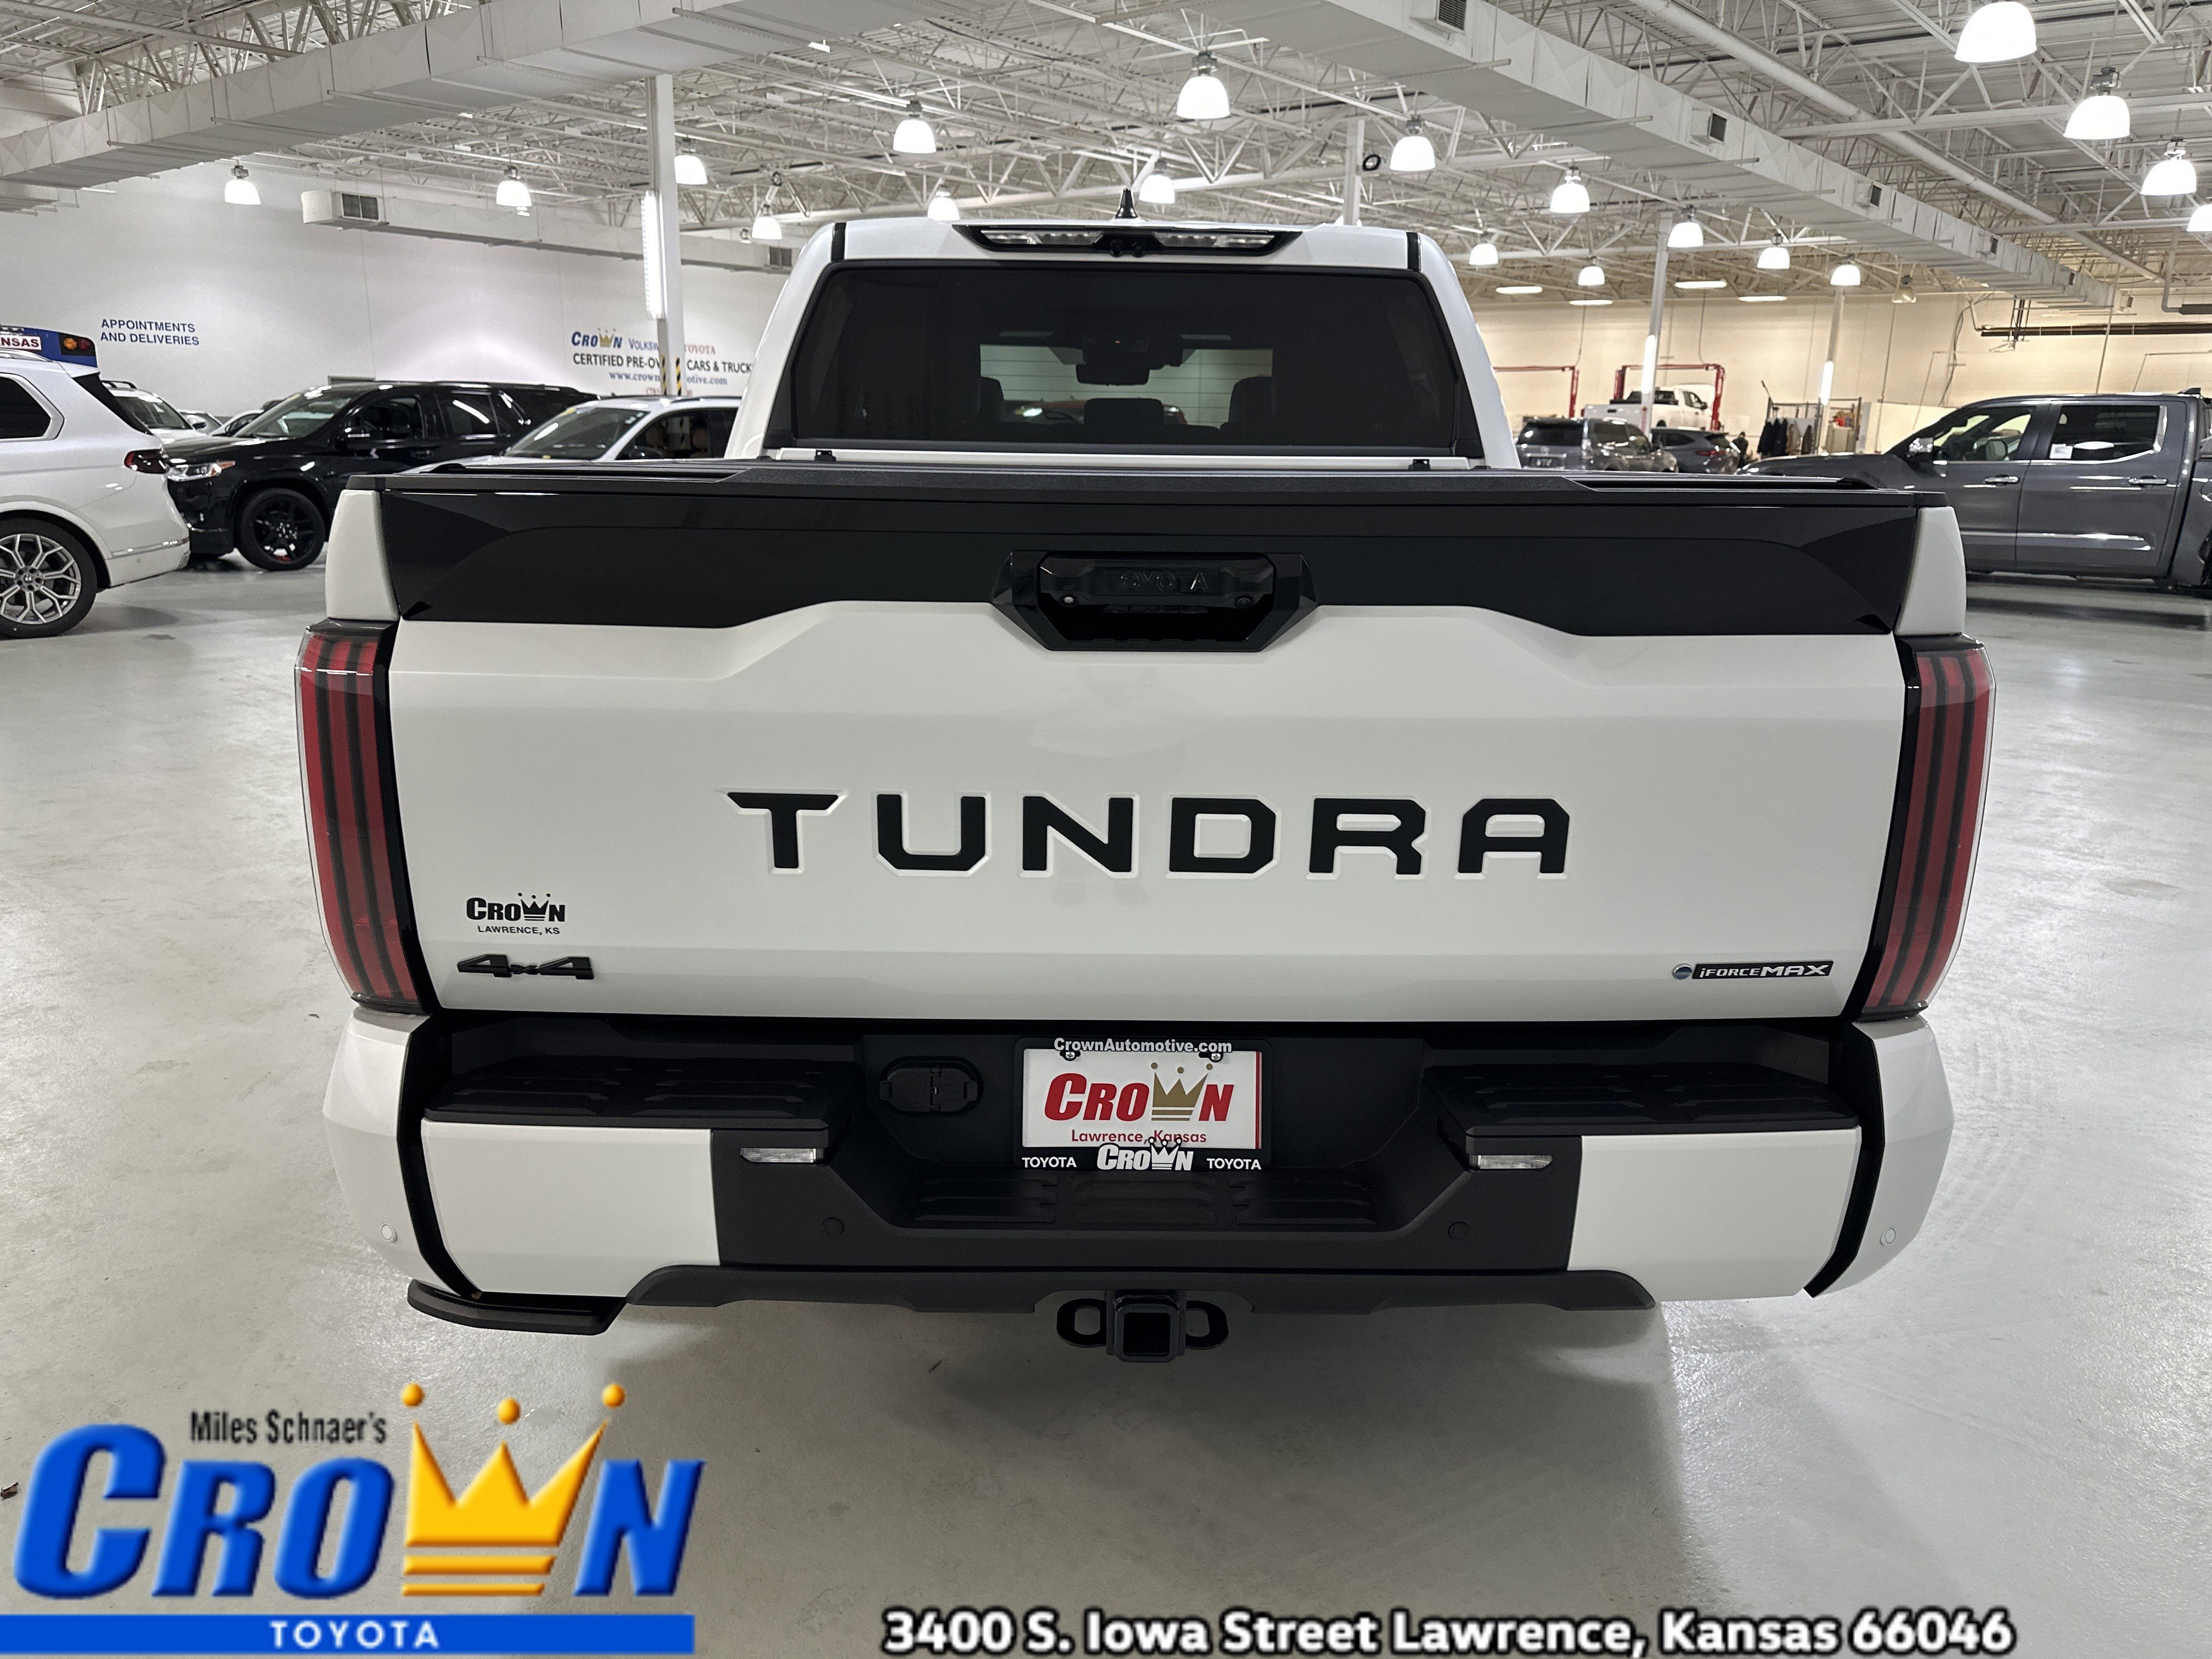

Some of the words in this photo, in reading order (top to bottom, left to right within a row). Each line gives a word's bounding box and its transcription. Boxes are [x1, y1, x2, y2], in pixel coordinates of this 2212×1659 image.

[101, 319, 196, 332] APPOINTMENTS
[0, 337, 39, 347] NSAS
[100, 332, 126, 342] AND
[129, 334, 199, 346] DELIVERIES
[573, 353, 624, 366] CERTIFIED
[627, 356, 659, 369] PRE-O
[687, 359, 711, 372] CARS
[713, 361, 719, 372] &
[722, 362, 752, 374] TRUCK
[1104, 571, 1210, 594] TOYOTA
[724, 791, 1572, 877] TUNDRA
[466, 893, 566, 922] CROWN
[477, 926, 543, 935] LAWRENCE,
[1054, 1037, 1232, 1053] CrownAutomotive.com
[1044, 1062, 1234, 1122] CROWN
[1071, 1129, 1148, 1144] Lawrence,
[1153, 1130, 1207, 1143] Kansas
[1097, 1137, 1194, 1171] CROWN
[1022, 1156, 1077, 1168] TOYOTA
[1206, 1158, 1262, 1170] TOYOTA
